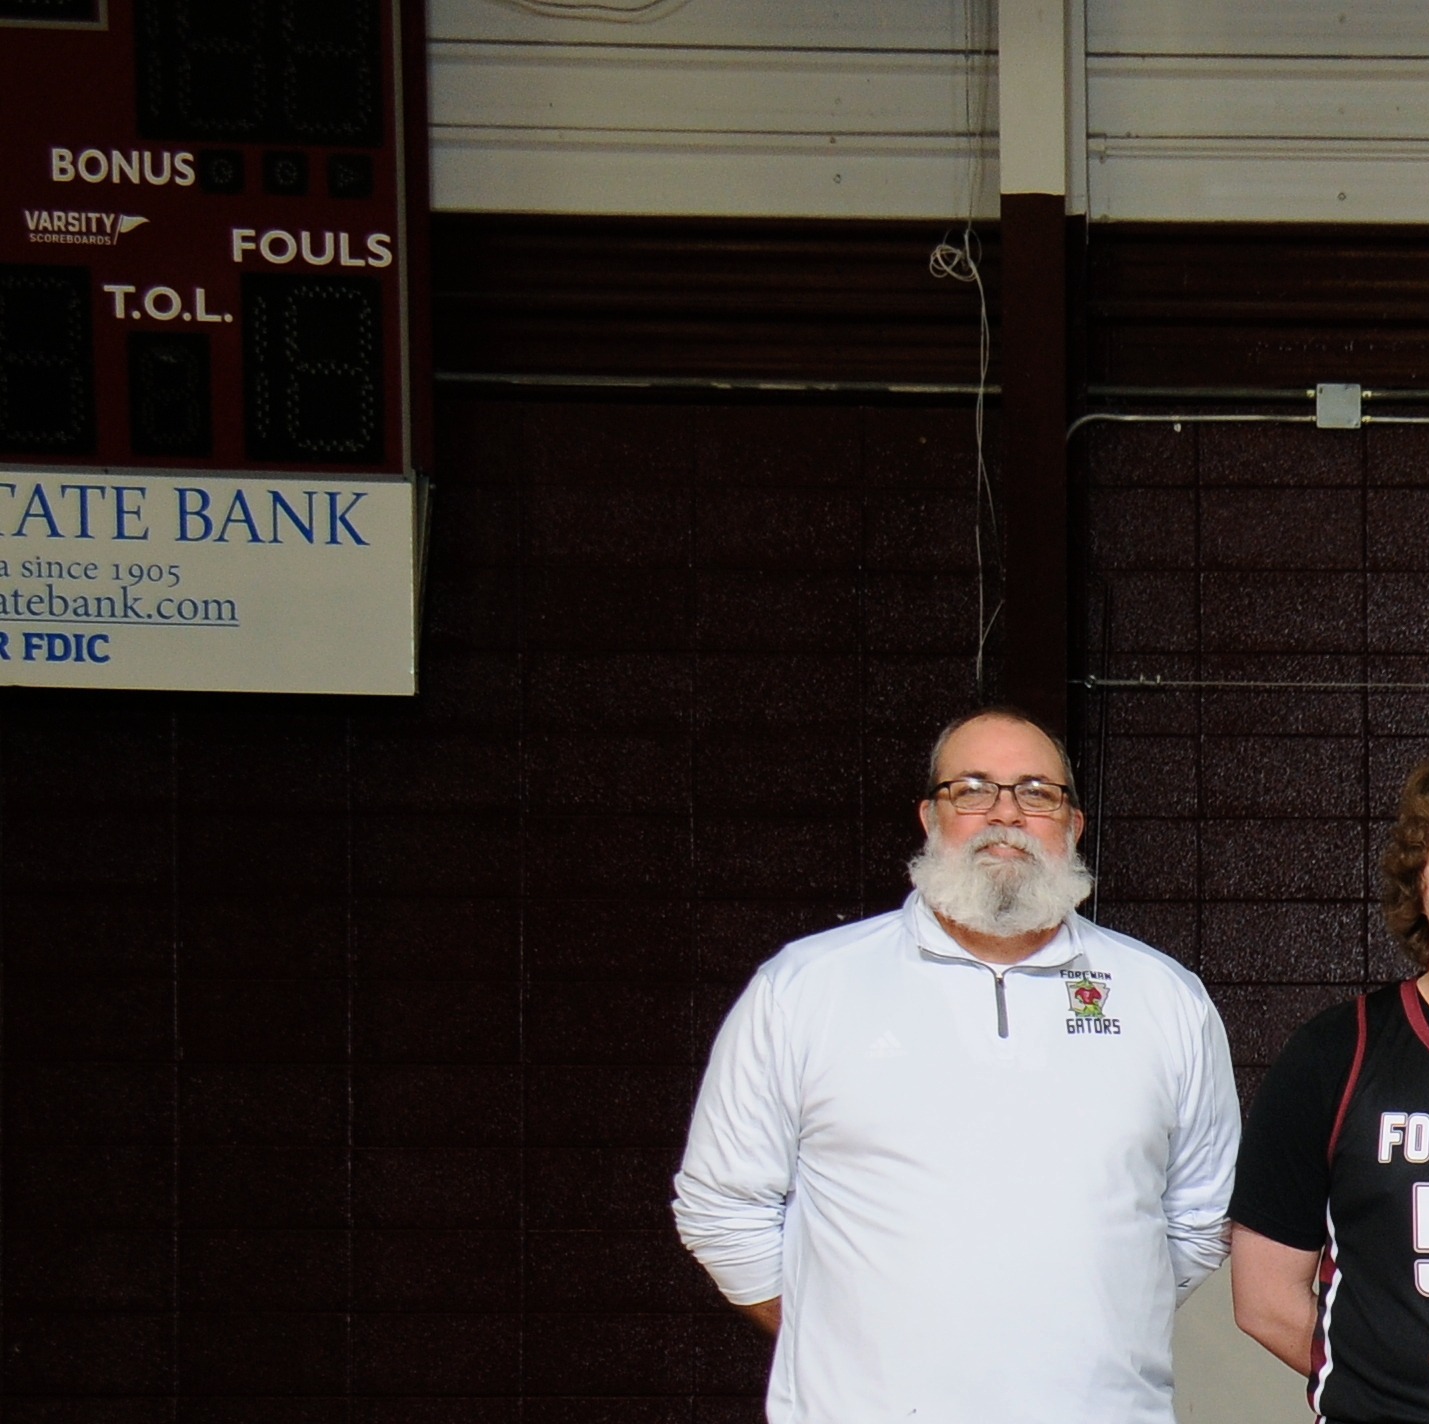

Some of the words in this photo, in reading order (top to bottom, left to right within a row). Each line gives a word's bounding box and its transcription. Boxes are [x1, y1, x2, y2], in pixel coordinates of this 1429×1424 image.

[52, 148, 196, 187] BONUS
[25, 210, 115, 234] VARSITY
[29, 233, 112, 246] SCOREBOARDS
[232, 228, 393, 268] FOULS
[103, 284, 233, 323] T.O.L.
[174, 487, 371, 546] BANK
[21, 556, 99, 580] since
[112, 563, 181, 588] 1905
[22, 631, 111, 664] FDIC
[1065, 1018, 1121, 1035] GATORS
